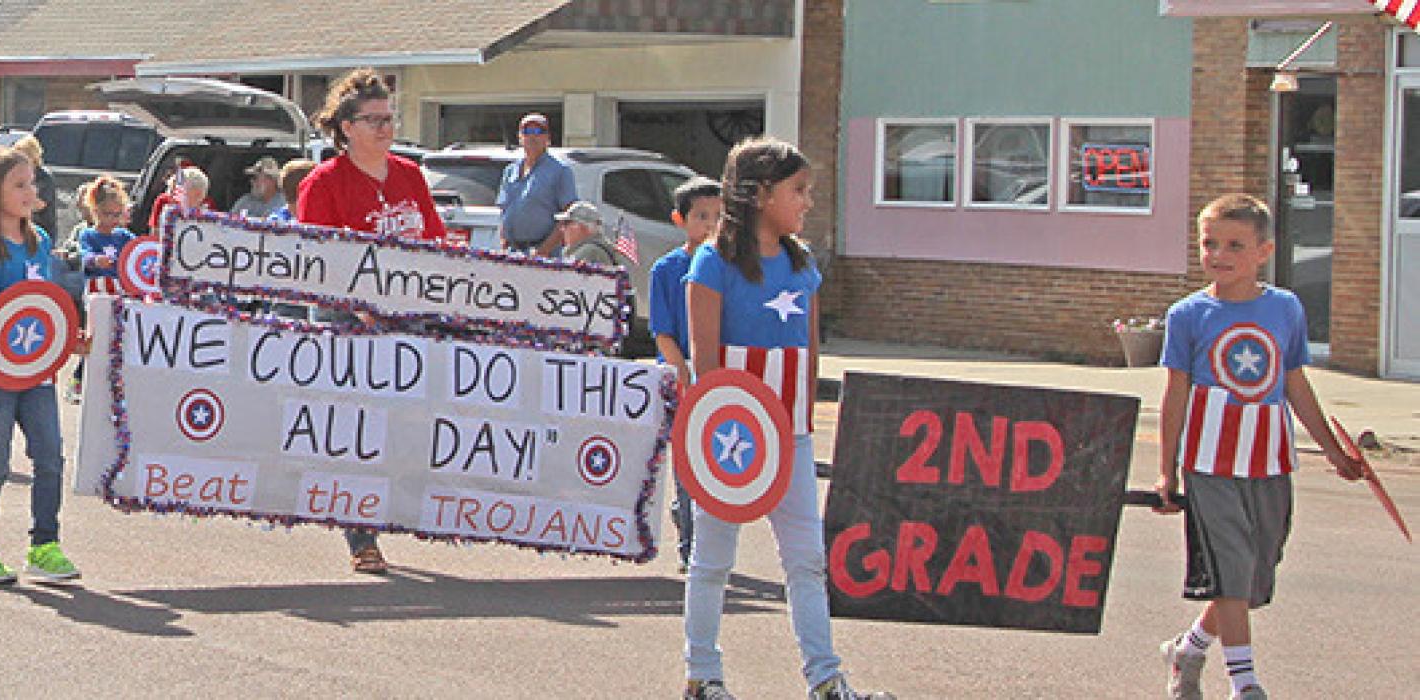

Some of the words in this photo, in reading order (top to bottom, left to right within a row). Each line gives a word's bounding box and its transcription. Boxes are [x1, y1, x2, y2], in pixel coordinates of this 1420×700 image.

[178, 225, 327, 287] Captain
[347, 243, 519, 311] America
[251, 331, 423, 392] COULD
[454, 347, 517, 402] DO
[546, 358, 651, 419] THIS
[283, 404, 380, 459] ALL
[430, 418, 558, 480] DAY!"
[896, 410, 1065, 491] 2ND
[145, 463, 249, 505] Beat
[307, 480, 380, 518] the
[430, 495, 626, 548] TROJANS
[830, 520, 1108, 607] GRADE
